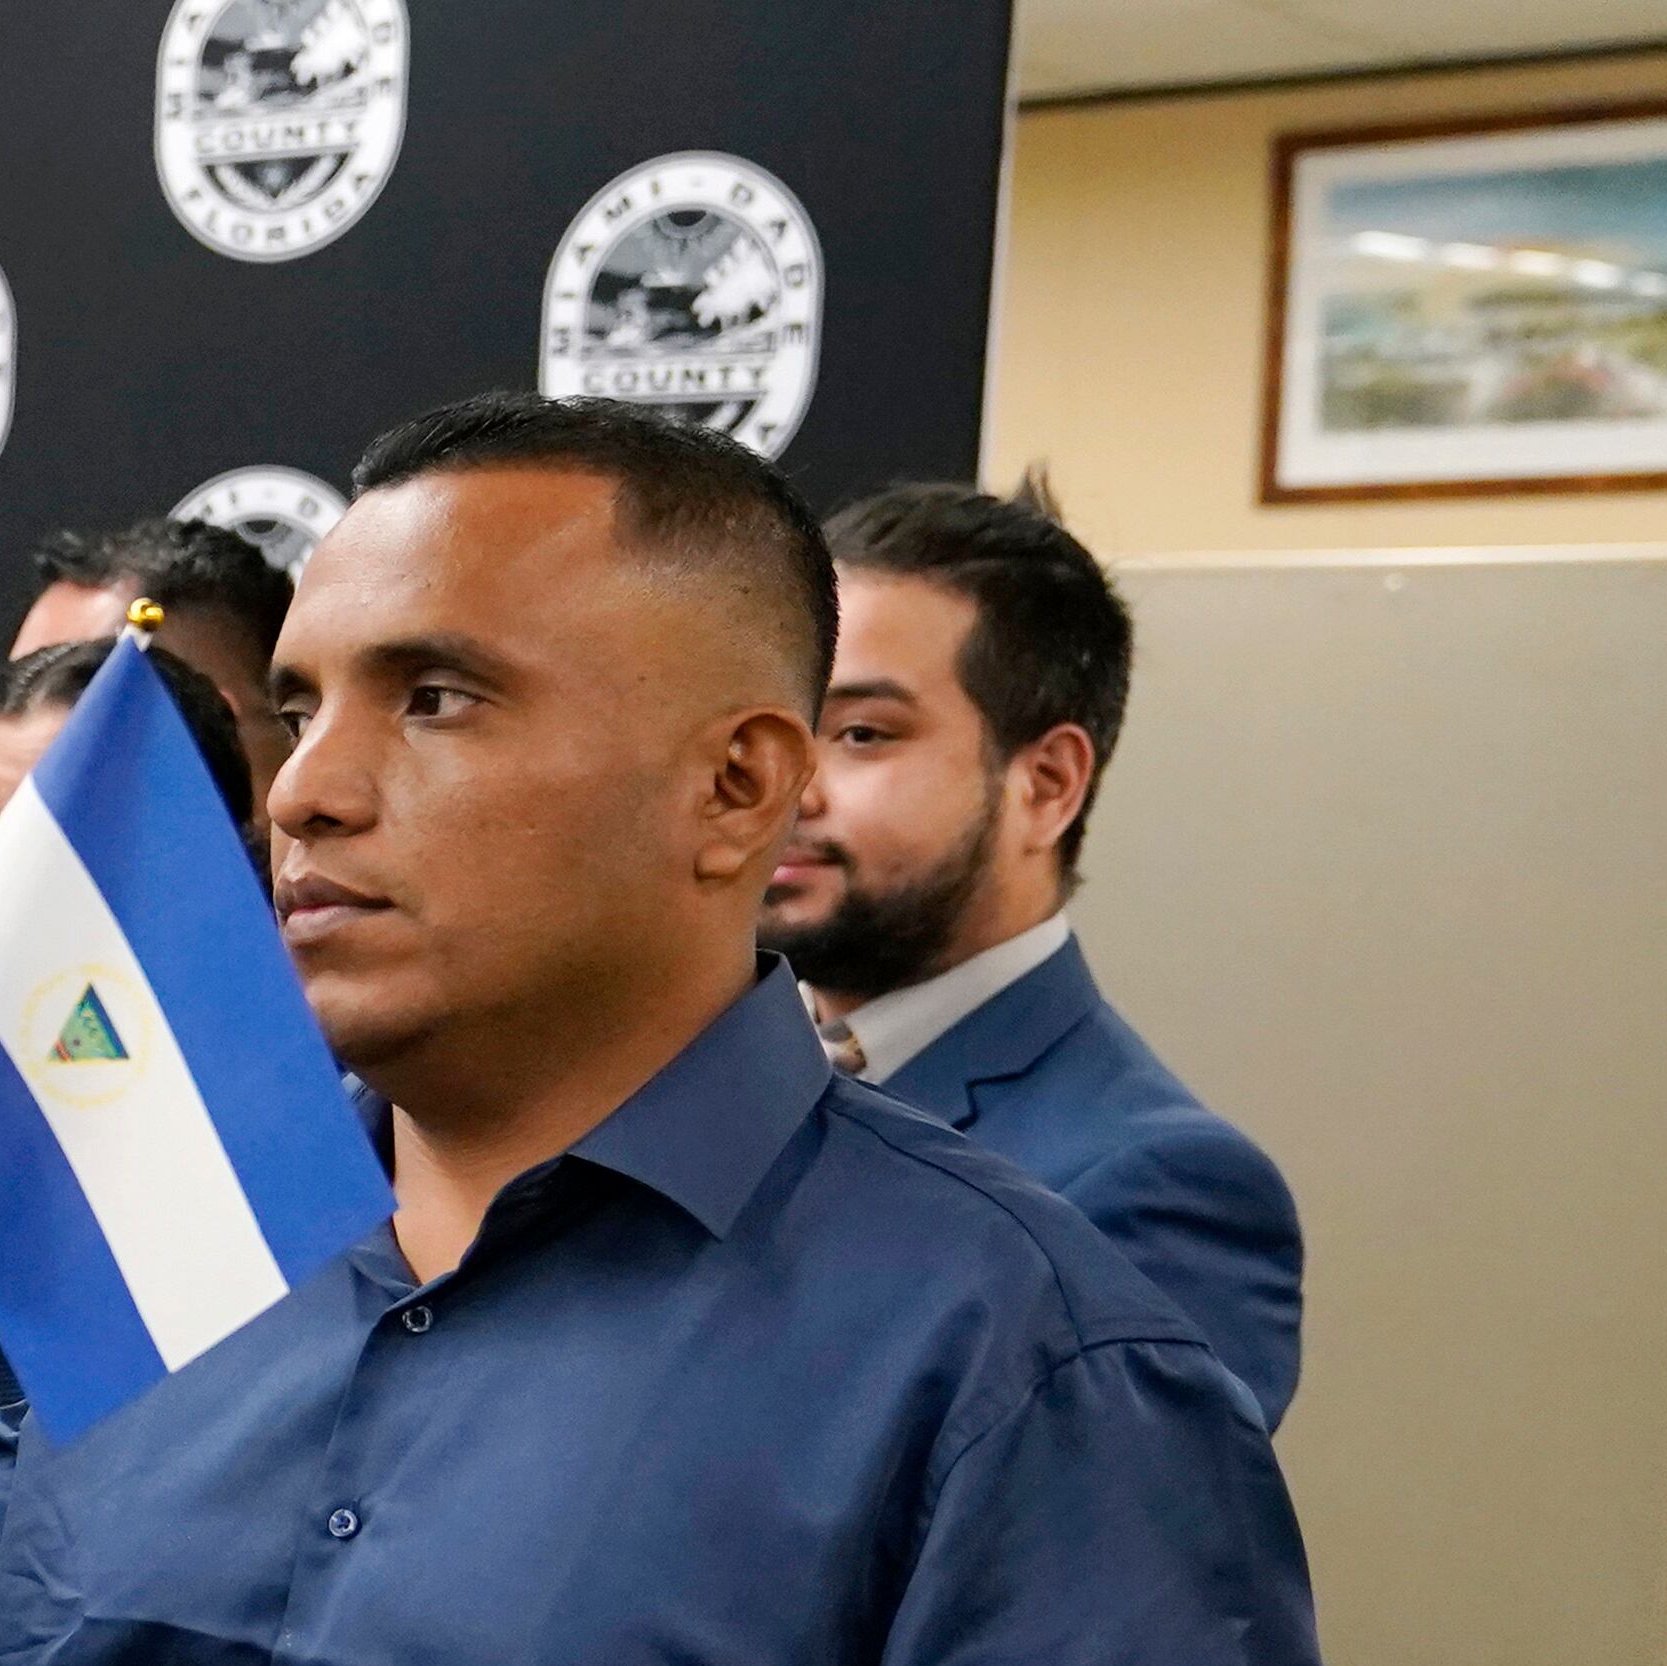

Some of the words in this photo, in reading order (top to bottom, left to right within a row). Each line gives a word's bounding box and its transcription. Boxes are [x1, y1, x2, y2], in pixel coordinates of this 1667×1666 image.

[195, 120, 357, 151] COUNTY
[182, 172, 371, 242] FLORIDA
[551, 170, 813, 357] MIAMI-DADE
[584, 366, 765, 395] COUNTY
